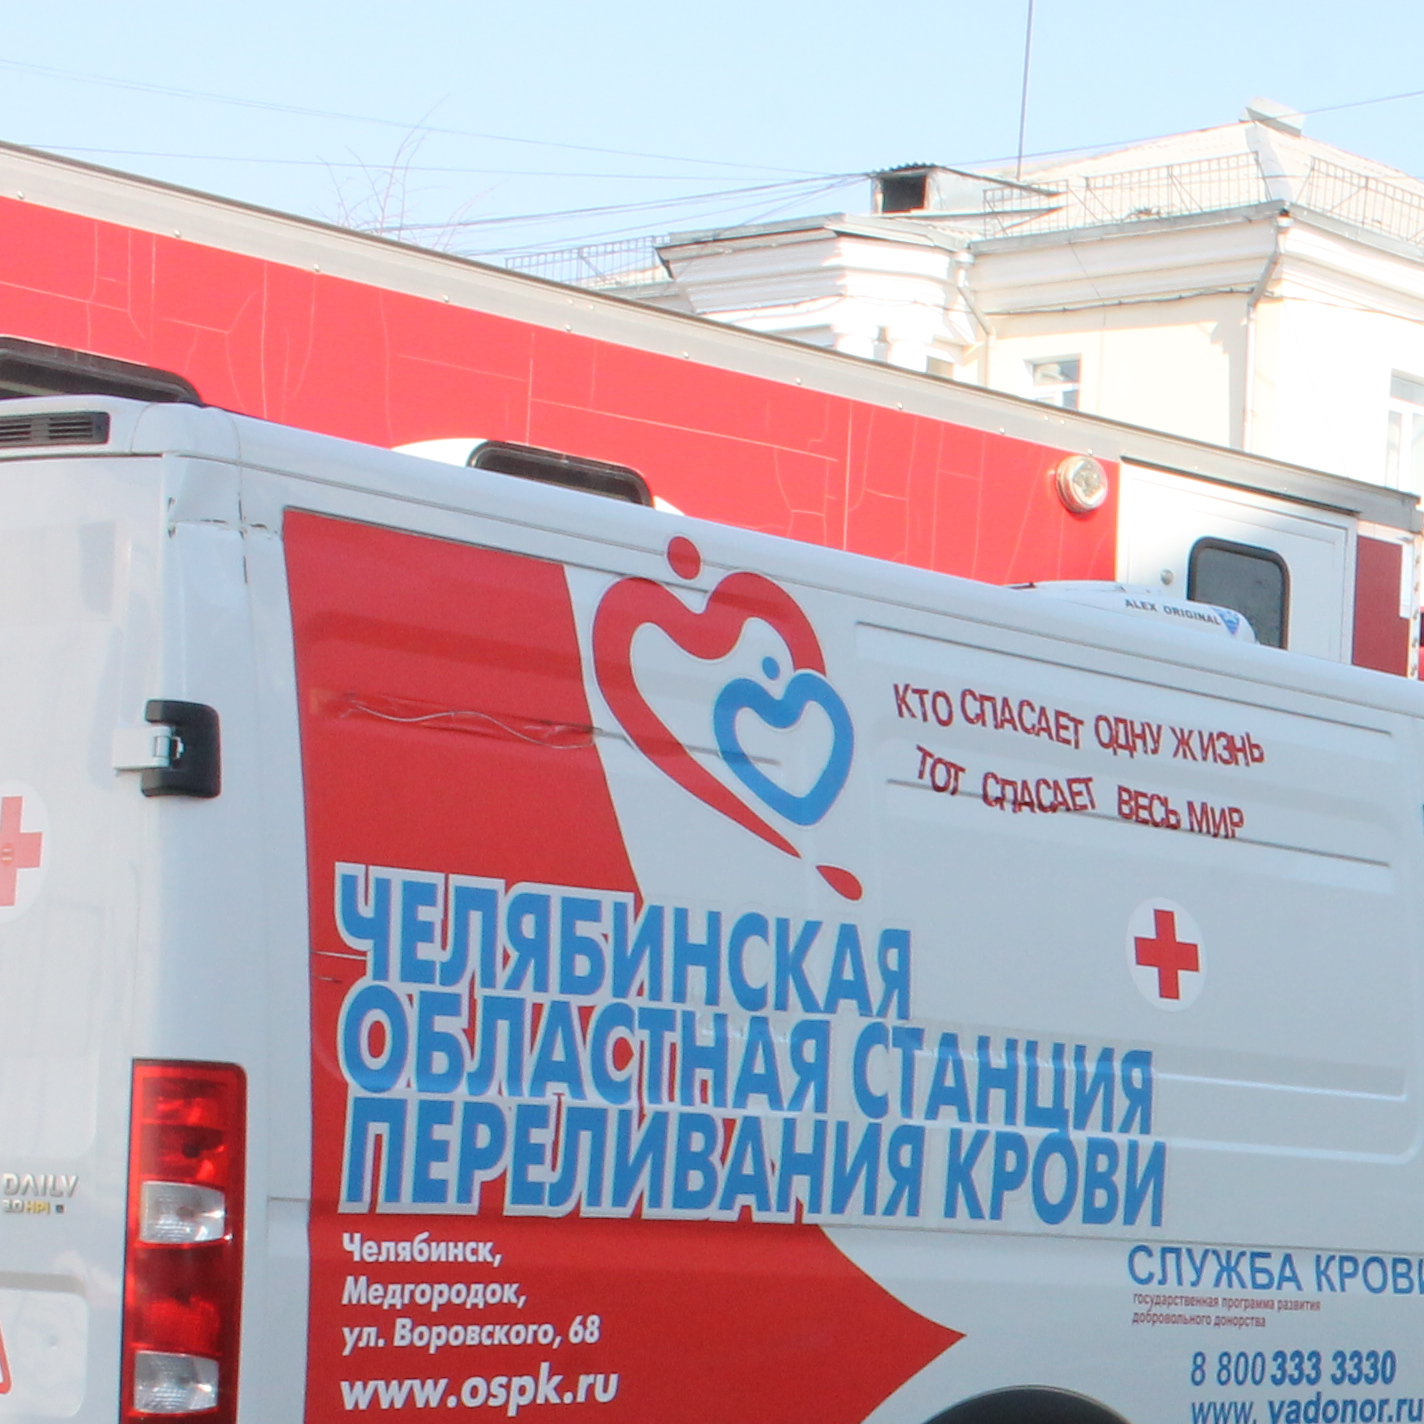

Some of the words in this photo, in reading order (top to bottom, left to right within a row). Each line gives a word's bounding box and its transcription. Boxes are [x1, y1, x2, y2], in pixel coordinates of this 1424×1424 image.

[1125, 599, 1158, 612] ALEX
[1163, 605, 1221, 625] ORIGINAL
[893, 683, 953, 727] КТО
[960, 688, 1084, 749] СПАСАЕТ
[1094, 714, 1163, 758] ОДНУ
[1169, 725, 1264, 767] ЖИЗНЬ
[916, 744, 966, 796] ТОТ
[982, 772, 1097, 813] СПАСАЕТ
[1117, 785, 1182, 829] ВЕСЬ
[1186, 800, 1245, 839] МИР
[340, 872, 911, 1020] ЧЕЛЯБИНСКАЯ
[342, 984, 830, 1113] ОБЛАСТНАЯ
[853, 1021, 1154, 1135] СТАНЦИЯ
[344, 1100, 926, 1218] ПЕРЕЛИВАНИЯ
[944, 1128, 1167, 1227] КРОВИ
[3, 1173, 79, 1198] DAILY
[342, 1231, 502, 1267] Челябинск,
[1128, 1244, 1303, 1292] СЛУЖБА
[341, 1275, 527, 1312] Медгородок,
[1133, 1292, 1219, 1311] государственная
[1222, 1297, 1274, 1311] программа
[1277, 1300, 1321, 1312] развития
[341, 1326, 386, 1356] ул.
[393, 1317, 562, 1355] Воровского,
[568, 1314, 601, 1344] 68
[1132, 1311, 1212, 1326] добровольного
[1214, 1315, 1266, 1329] донорства
[340, 1361, 619, 1417] www.ospk.ru
[1190, 1351, 1206, 1387] 8
[1216, 1351, 1266, 1387] 800
[1270, 1350, 1322, 1386] 333
[1331, 1350, 1397, 1386] 3330
